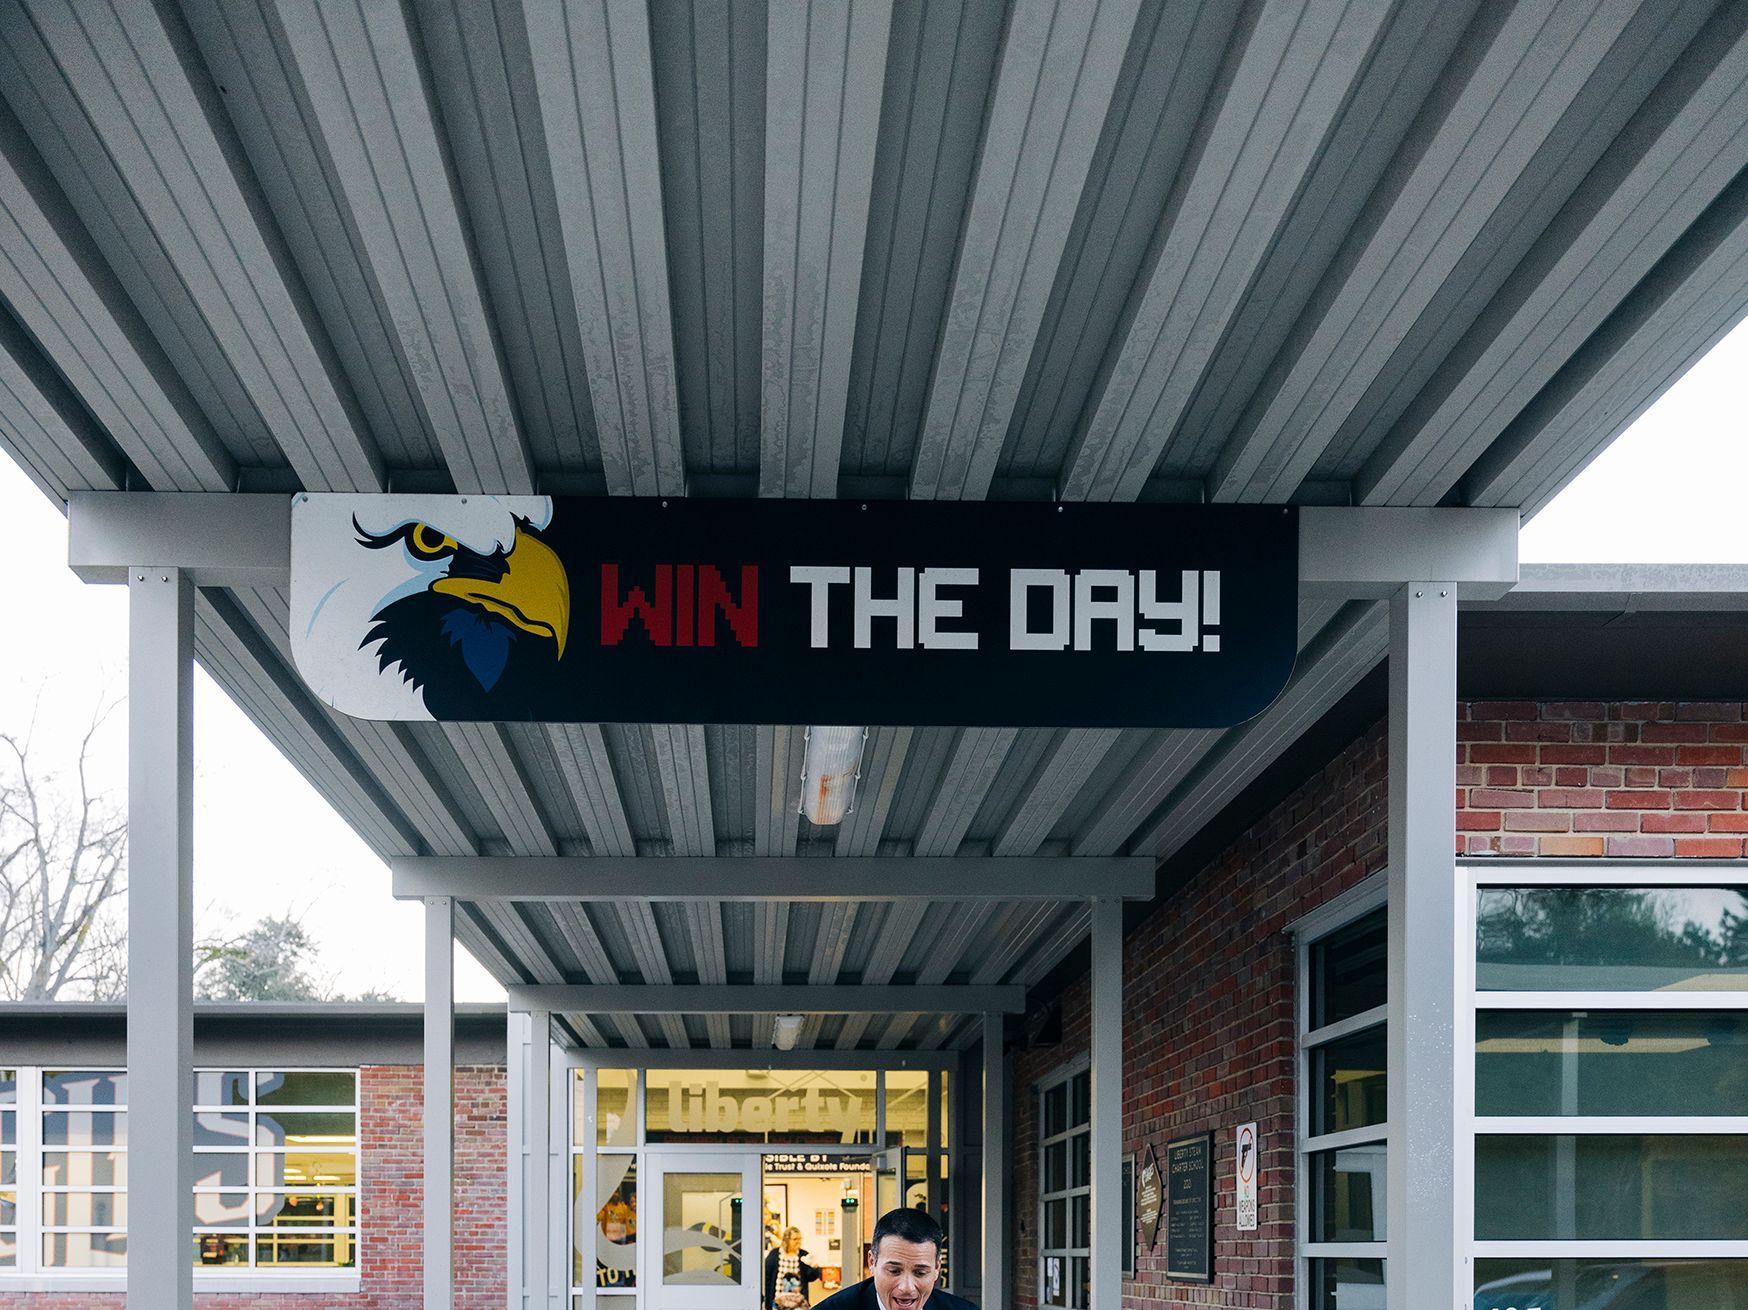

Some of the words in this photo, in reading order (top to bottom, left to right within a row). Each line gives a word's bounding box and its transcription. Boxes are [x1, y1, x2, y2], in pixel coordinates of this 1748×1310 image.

[600, 563, 759, 647] WIN
[789, 565, 980, 650] THE
[1010, 568, 1221, 652] DAY!
[668, 1080, 863, 1144] liberty
[775, 1163, 795, 1171] Trust
